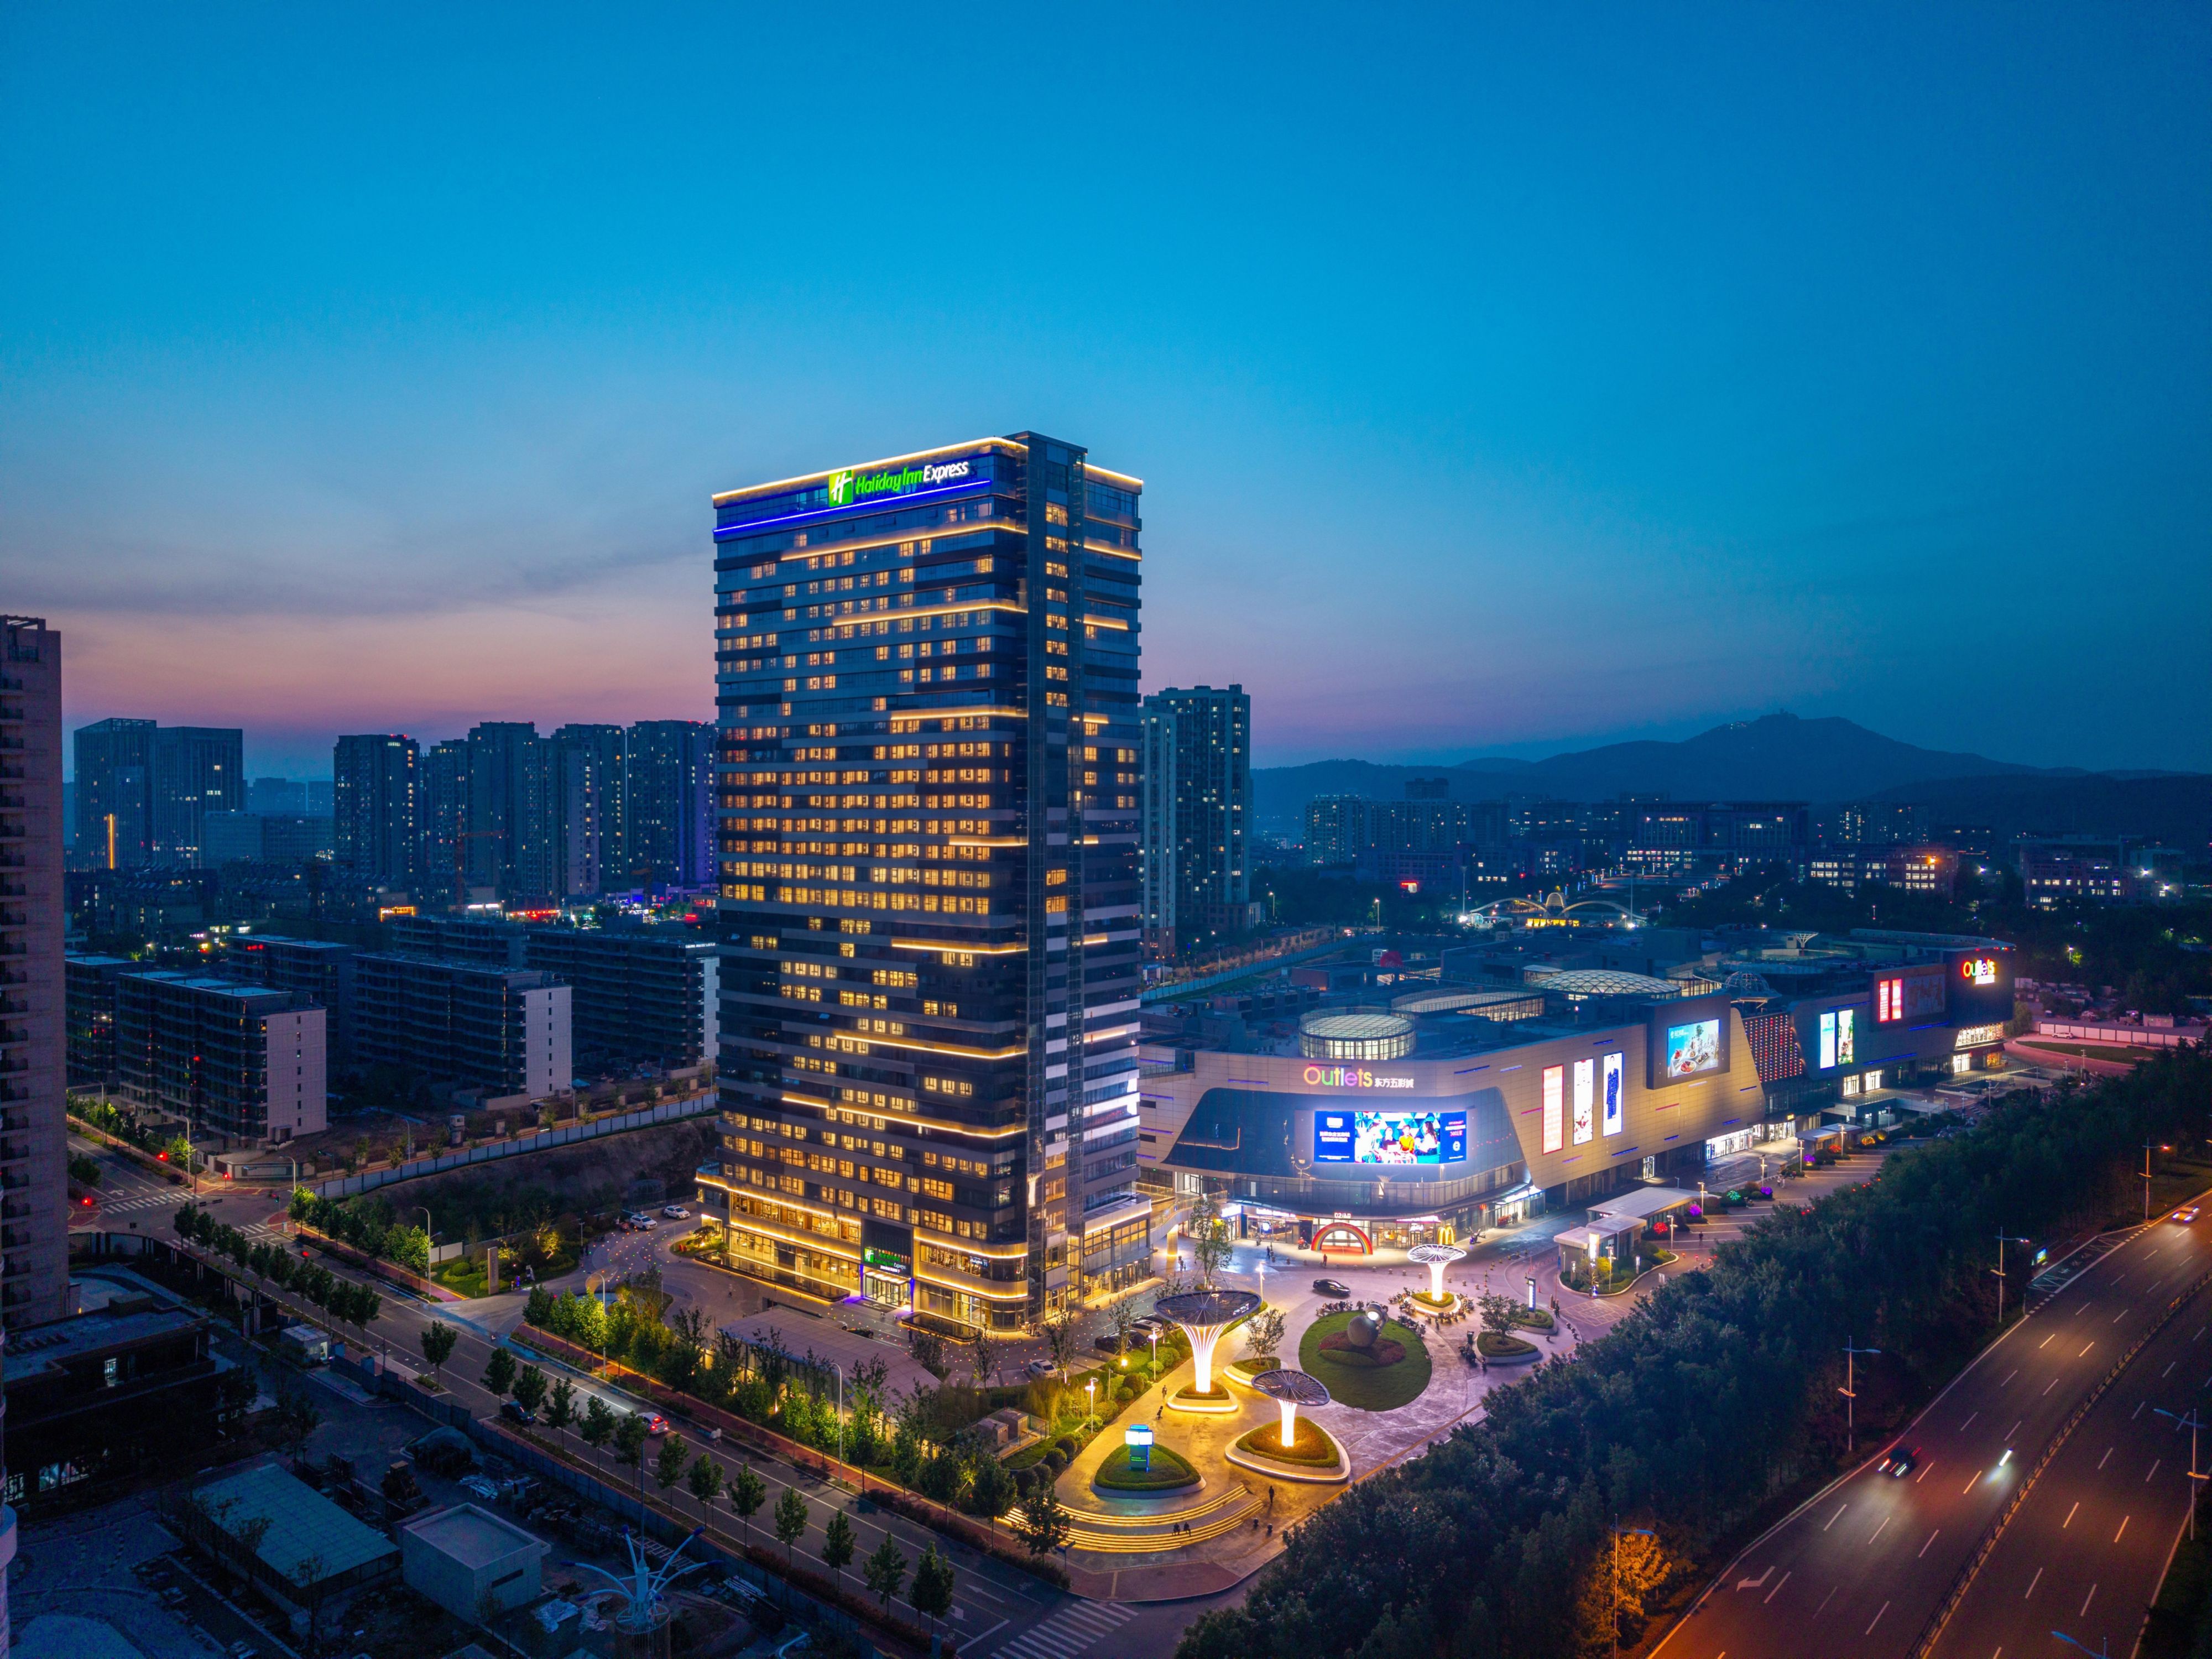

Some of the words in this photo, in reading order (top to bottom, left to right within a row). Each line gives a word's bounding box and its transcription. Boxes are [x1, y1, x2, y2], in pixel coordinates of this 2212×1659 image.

[855, 471, 901, 494] Holiday
[902, 467, 923, 486] Inn
[923, 461, 969, 483] Express
[1303, 1066, 1373, 1087] Outlets
